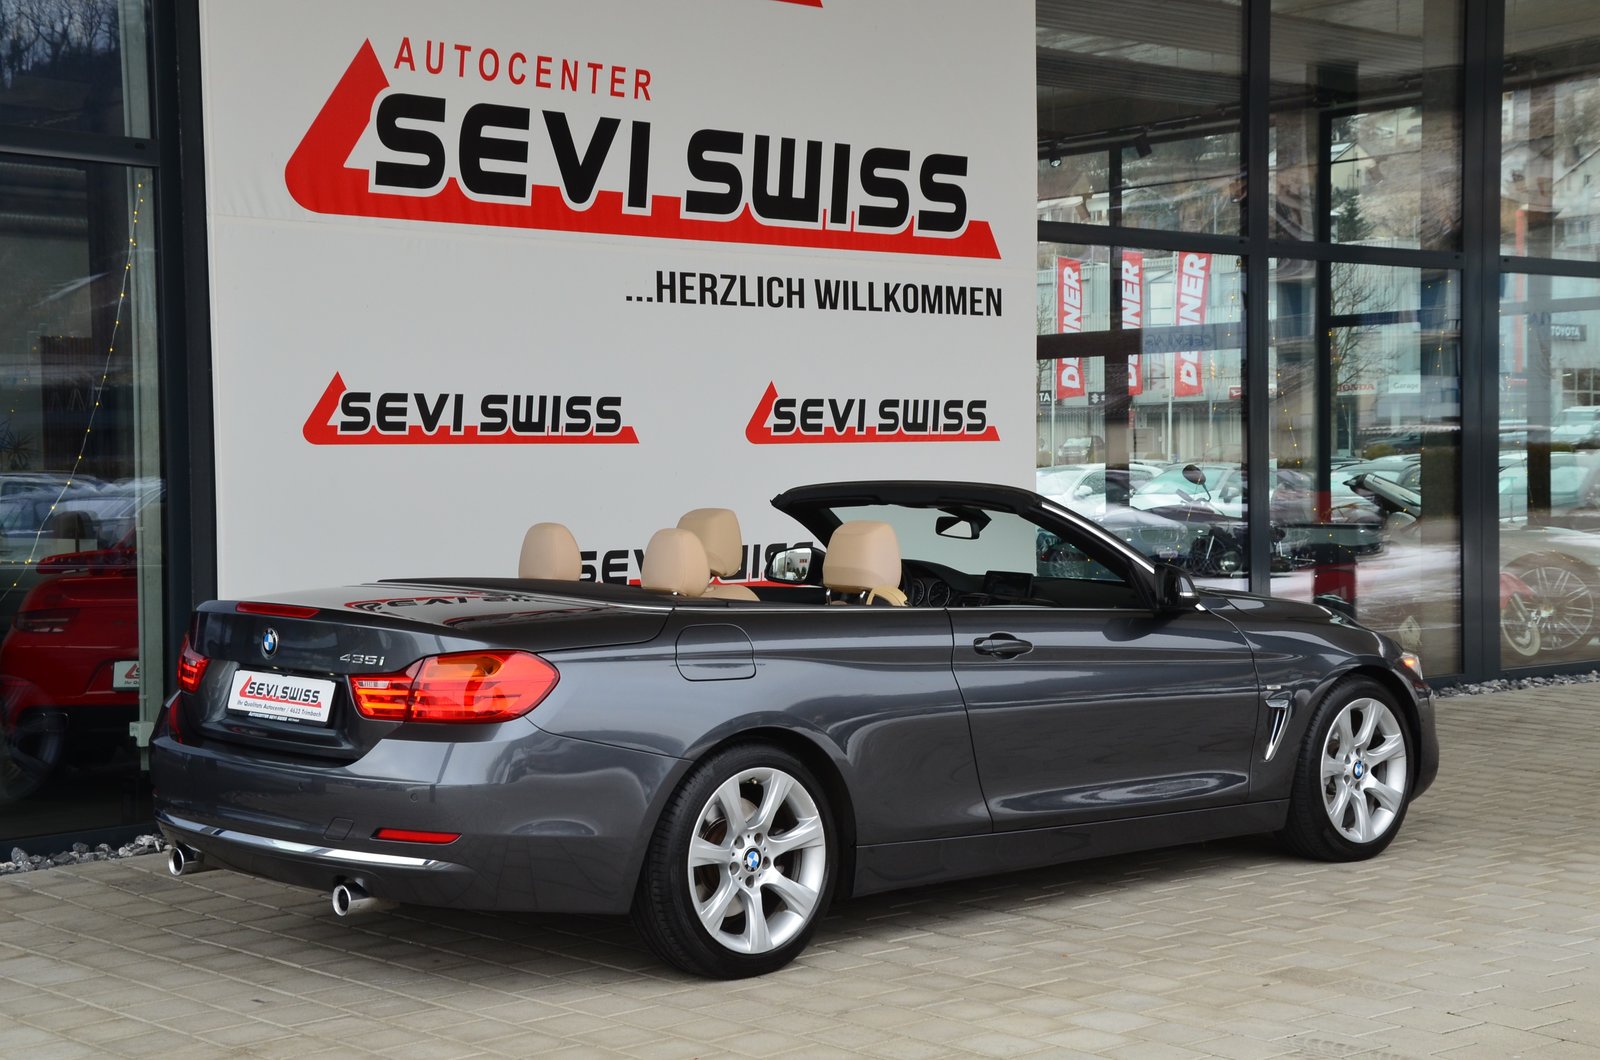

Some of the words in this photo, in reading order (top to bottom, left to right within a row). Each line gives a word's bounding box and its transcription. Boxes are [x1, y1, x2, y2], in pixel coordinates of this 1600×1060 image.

[394, 37, 651, 101] AUTOCENTER
[375, 92, 651, 208] SEVI
[685, 129, 968, 232] SWISS
[625, 270, 805, 309] ...HERZLICH
[815, 279, 1002, 317] WILLKOMMEN
[340, 392, 464, 433] SEVI
[480, 394, 622, 433] SWISS
[773, 398, 866, 433] SEVI
[878, 399, 987, 432] SWISS
[340, 653, 385, 666] 435i
[247, 682, 279, 697] SEVI
[281, 686, 320, 703] SWISS
